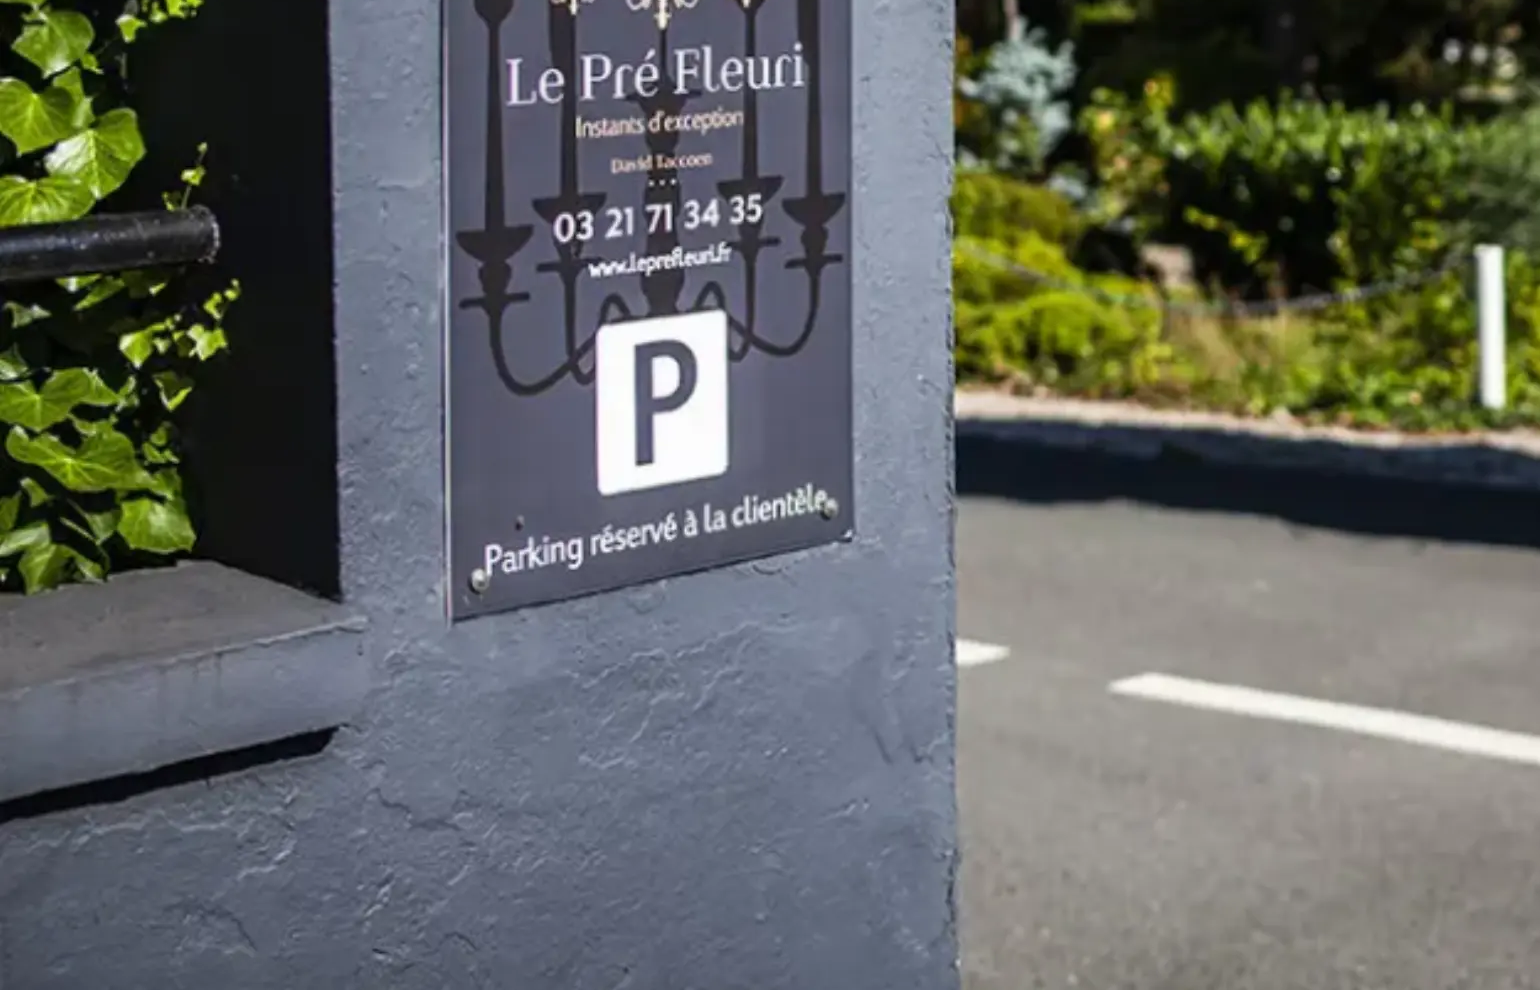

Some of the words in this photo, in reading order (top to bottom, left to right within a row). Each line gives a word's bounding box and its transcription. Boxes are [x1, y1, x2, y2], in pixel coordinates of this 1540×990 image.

[506, 57, 566, 106] Le
[580, 48, 660, 101] Pré
[673, 42, 805, 95] Fleuri
[575, 113, 644, 139] Instants
[648, 106, 744, 135] d'exception
[610, 155, 652, 174] David
[552, 210, 594, 243] 03
[604, 206, 634, 239] 21
[645, 202, 673, 234] 71
[684, 198, 720, 229] 34
[729, 193, 763, 225] 35
[633, 339, 698, 466] P
[484, 536, 584, 576] Parking
[590, 512, 678, 554] réservé
[684, 510, 698, 538] à
[703, 504, 727, 534] la
